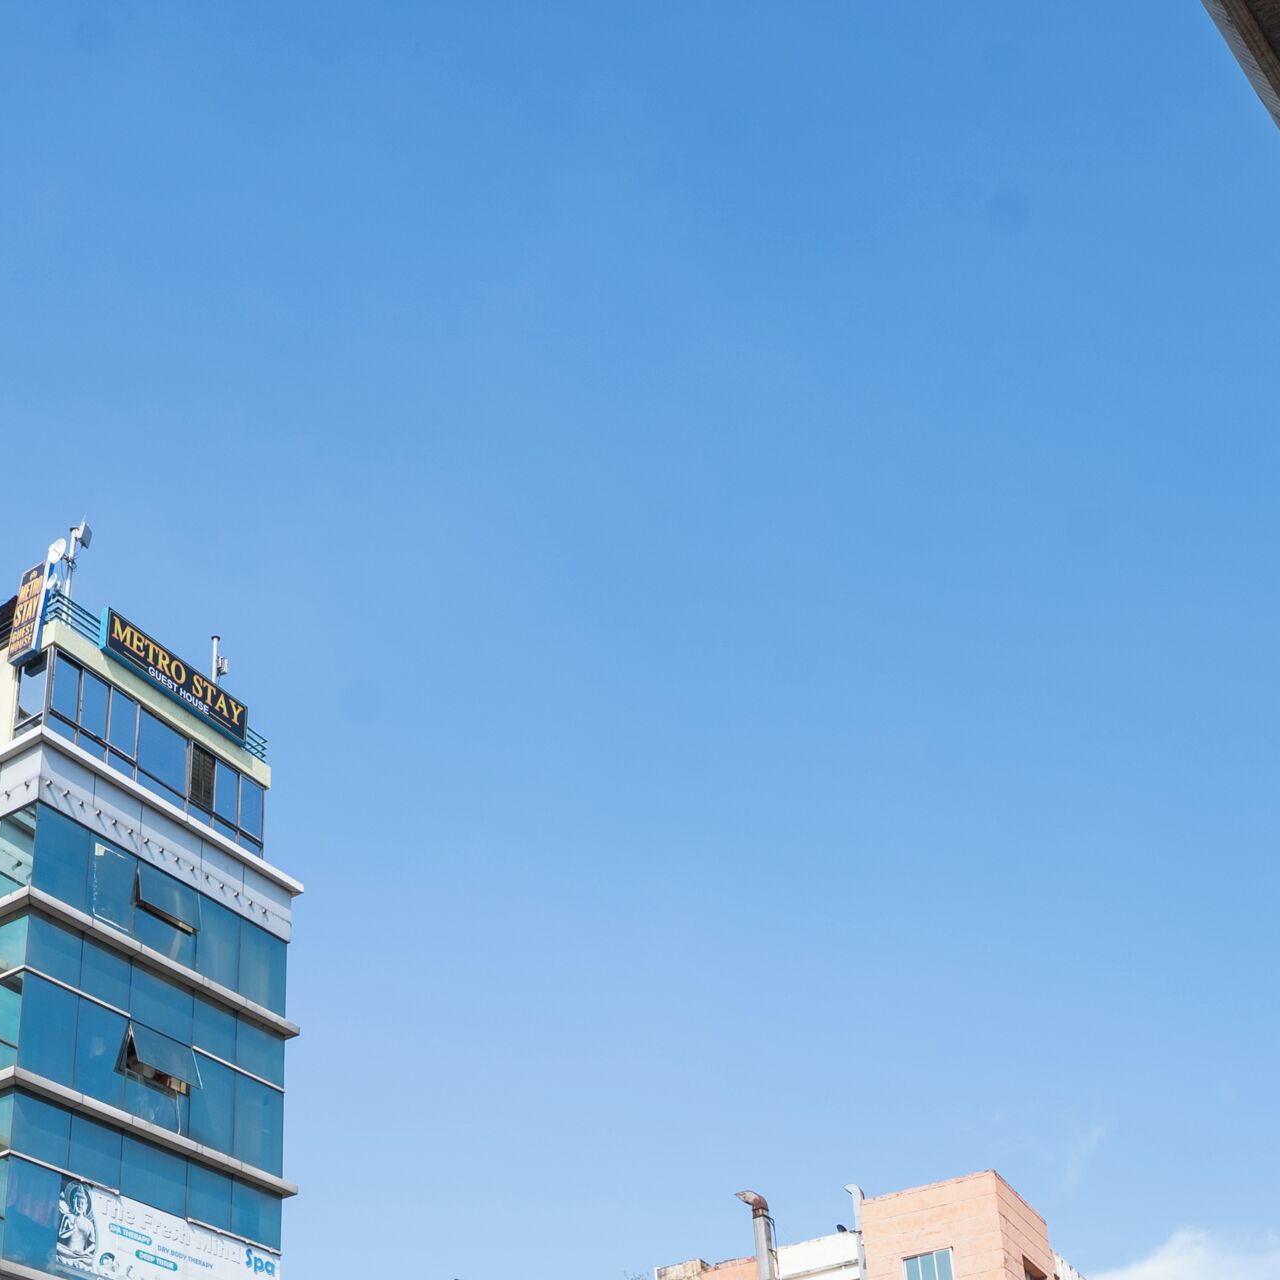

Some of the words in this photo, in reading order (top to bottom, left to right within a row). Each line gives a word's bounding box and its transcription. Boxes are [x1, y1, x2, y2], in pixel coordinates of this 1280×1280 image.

[15, 597, 39, 625] STAY
[111, 615, 186, 685] METRO
[192, 674, 245, 725] STAY
[148, 666, 180, 692] GUEST
[179, 686, 210, 714] HOUSE
[101, 1198, 136, 1225] The
[140, 1210, 191, 1247] Fresh
[245, 1248, 276, 1277] Spa
[109, 1224, 121, 1235] SPA
[121, 1228, 152, 1245] THERAPY
[138, 1252, 155, 1263] DEEP
[157, 1245, 170, 1253] DRY
[170, 1249, 187, 1261] BODY
[187, 1254, 214, 1269] THERAPY
